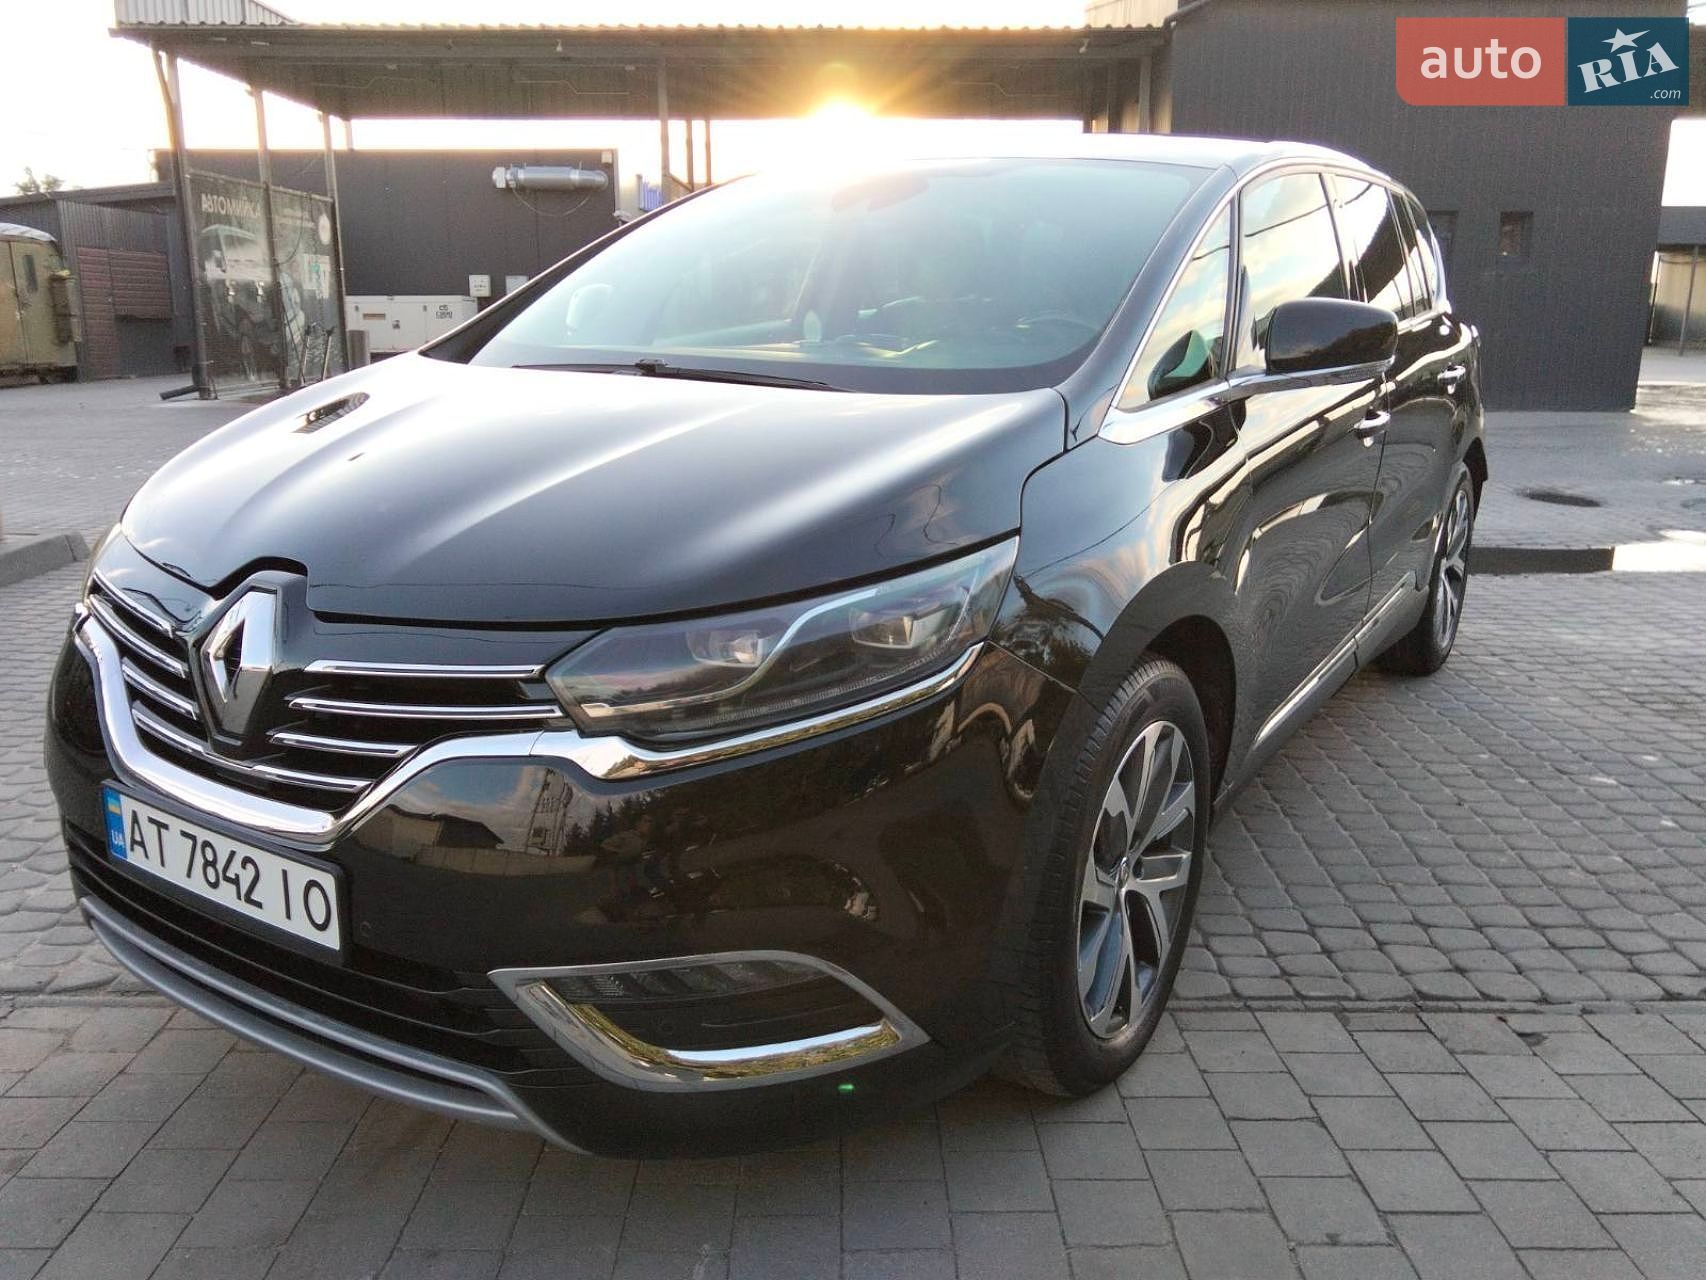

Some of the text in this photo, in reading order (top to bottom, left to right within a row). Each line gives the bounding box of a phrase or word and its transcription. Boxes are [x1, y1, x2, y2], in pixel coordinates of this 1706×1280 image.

[111, 830, 125, 849] UA
[129, 809, 332, 932] AT 7842 IO
